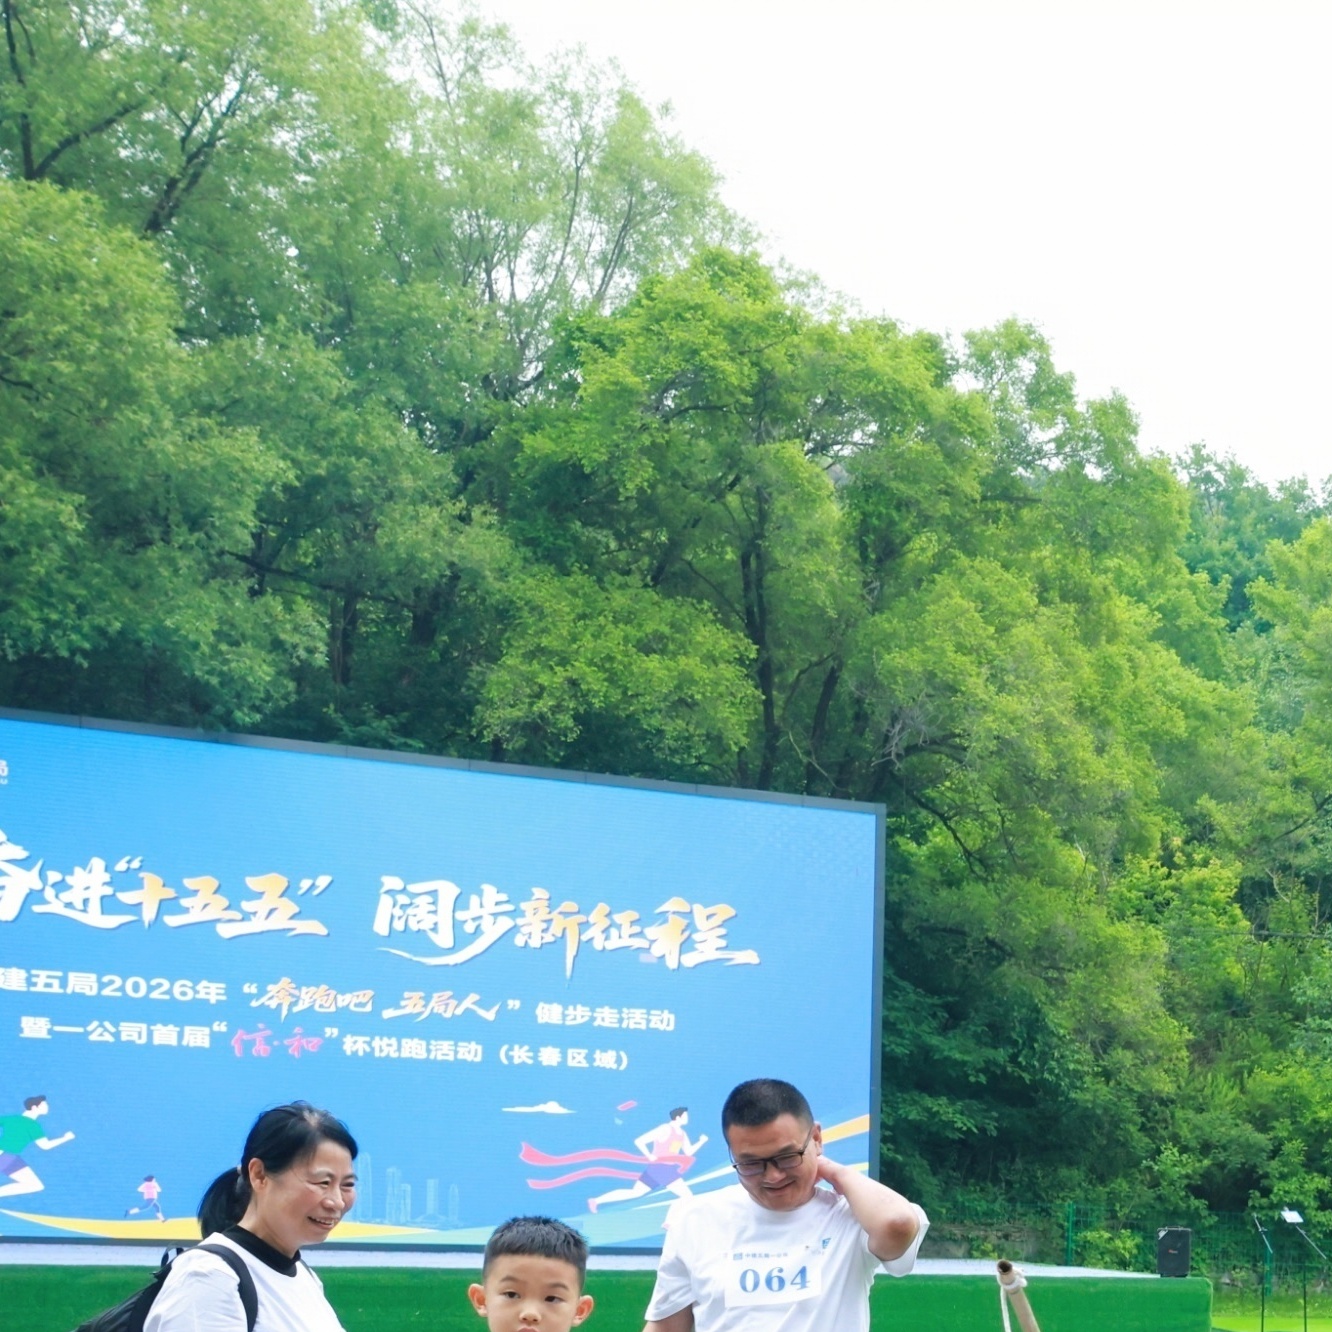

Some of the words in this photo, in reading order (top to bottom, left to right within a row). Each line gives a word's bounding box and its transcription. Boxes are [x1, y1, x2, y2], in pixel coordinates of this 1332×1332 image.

[372, 875, 762, 981] 阔步新征程
[535, 1001, 676, 1032] 健步走活动
[739, 1265, 811, 1293] 064
